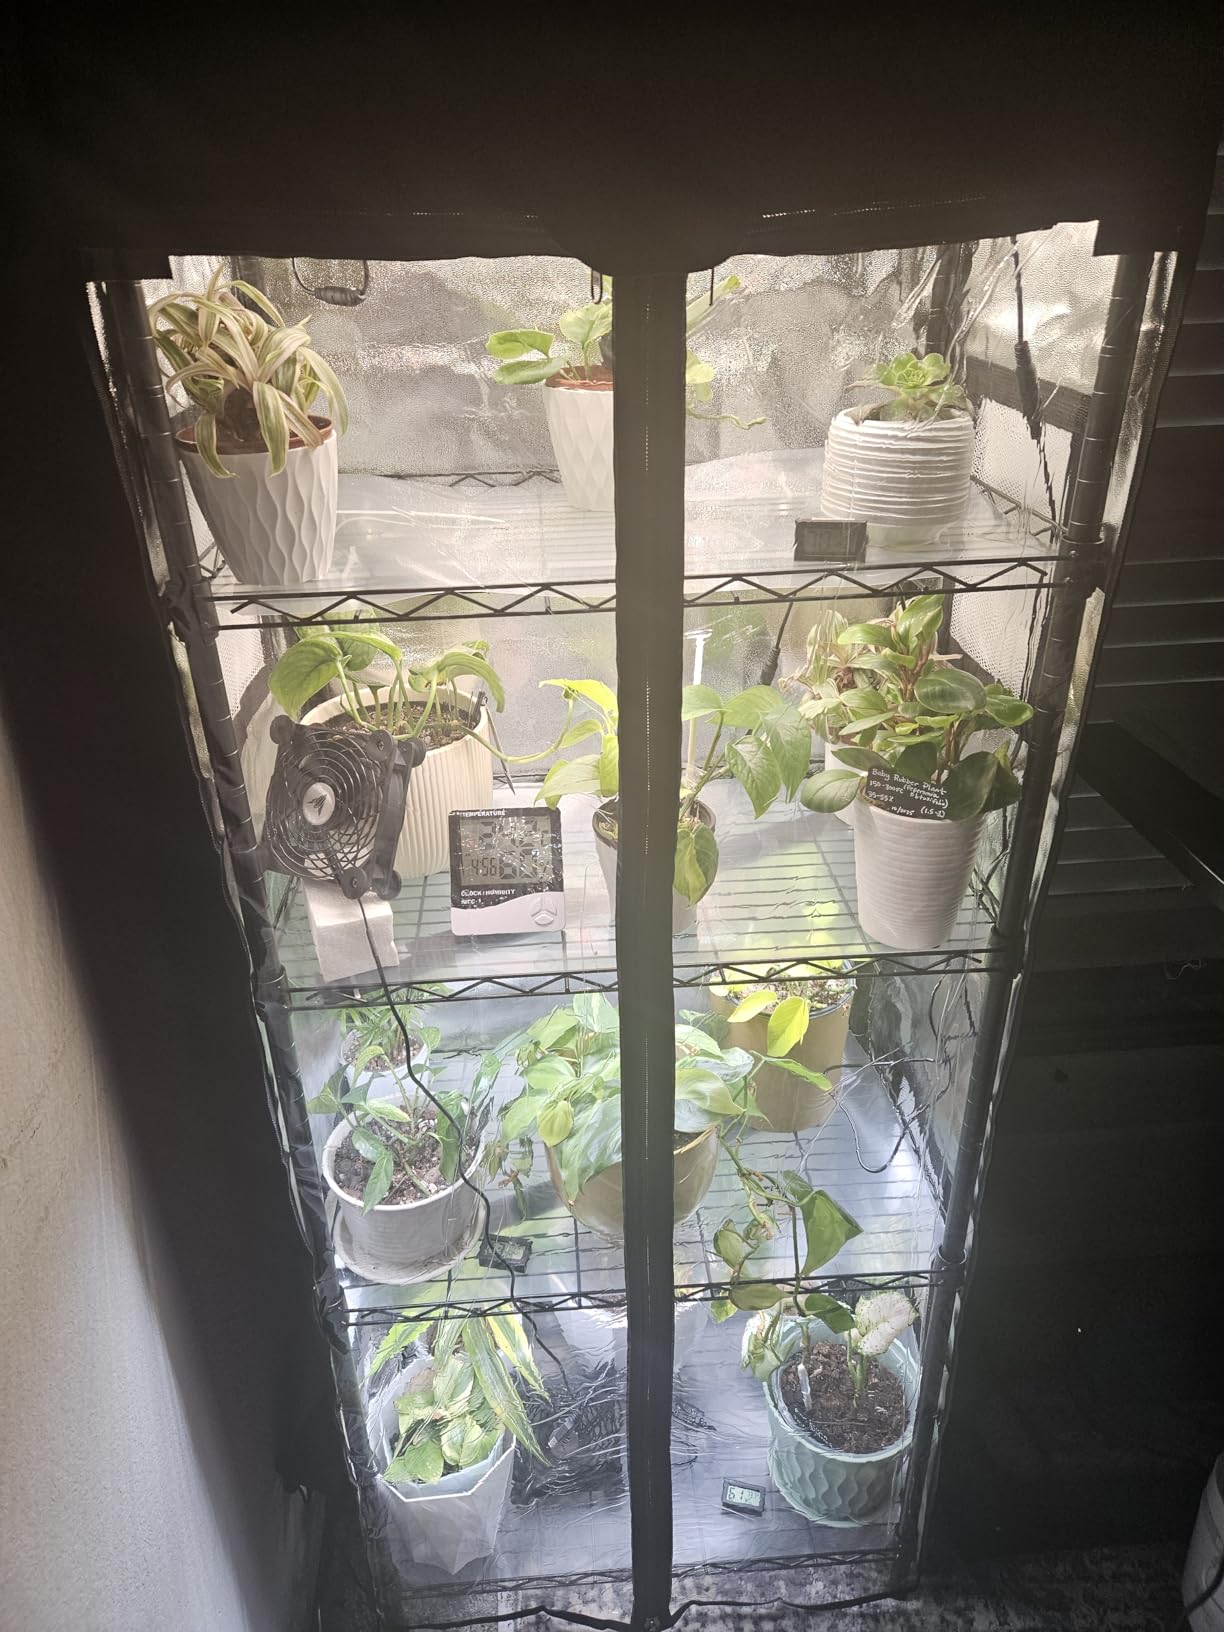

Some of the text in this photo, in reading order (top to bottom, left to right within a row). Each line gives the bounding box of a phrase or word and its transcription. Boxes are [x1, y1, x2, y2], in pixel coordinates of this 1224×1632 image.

[872, 768, 947, 795] Baby Rubber Plant
[471, 857, 497, 876] 4:56
